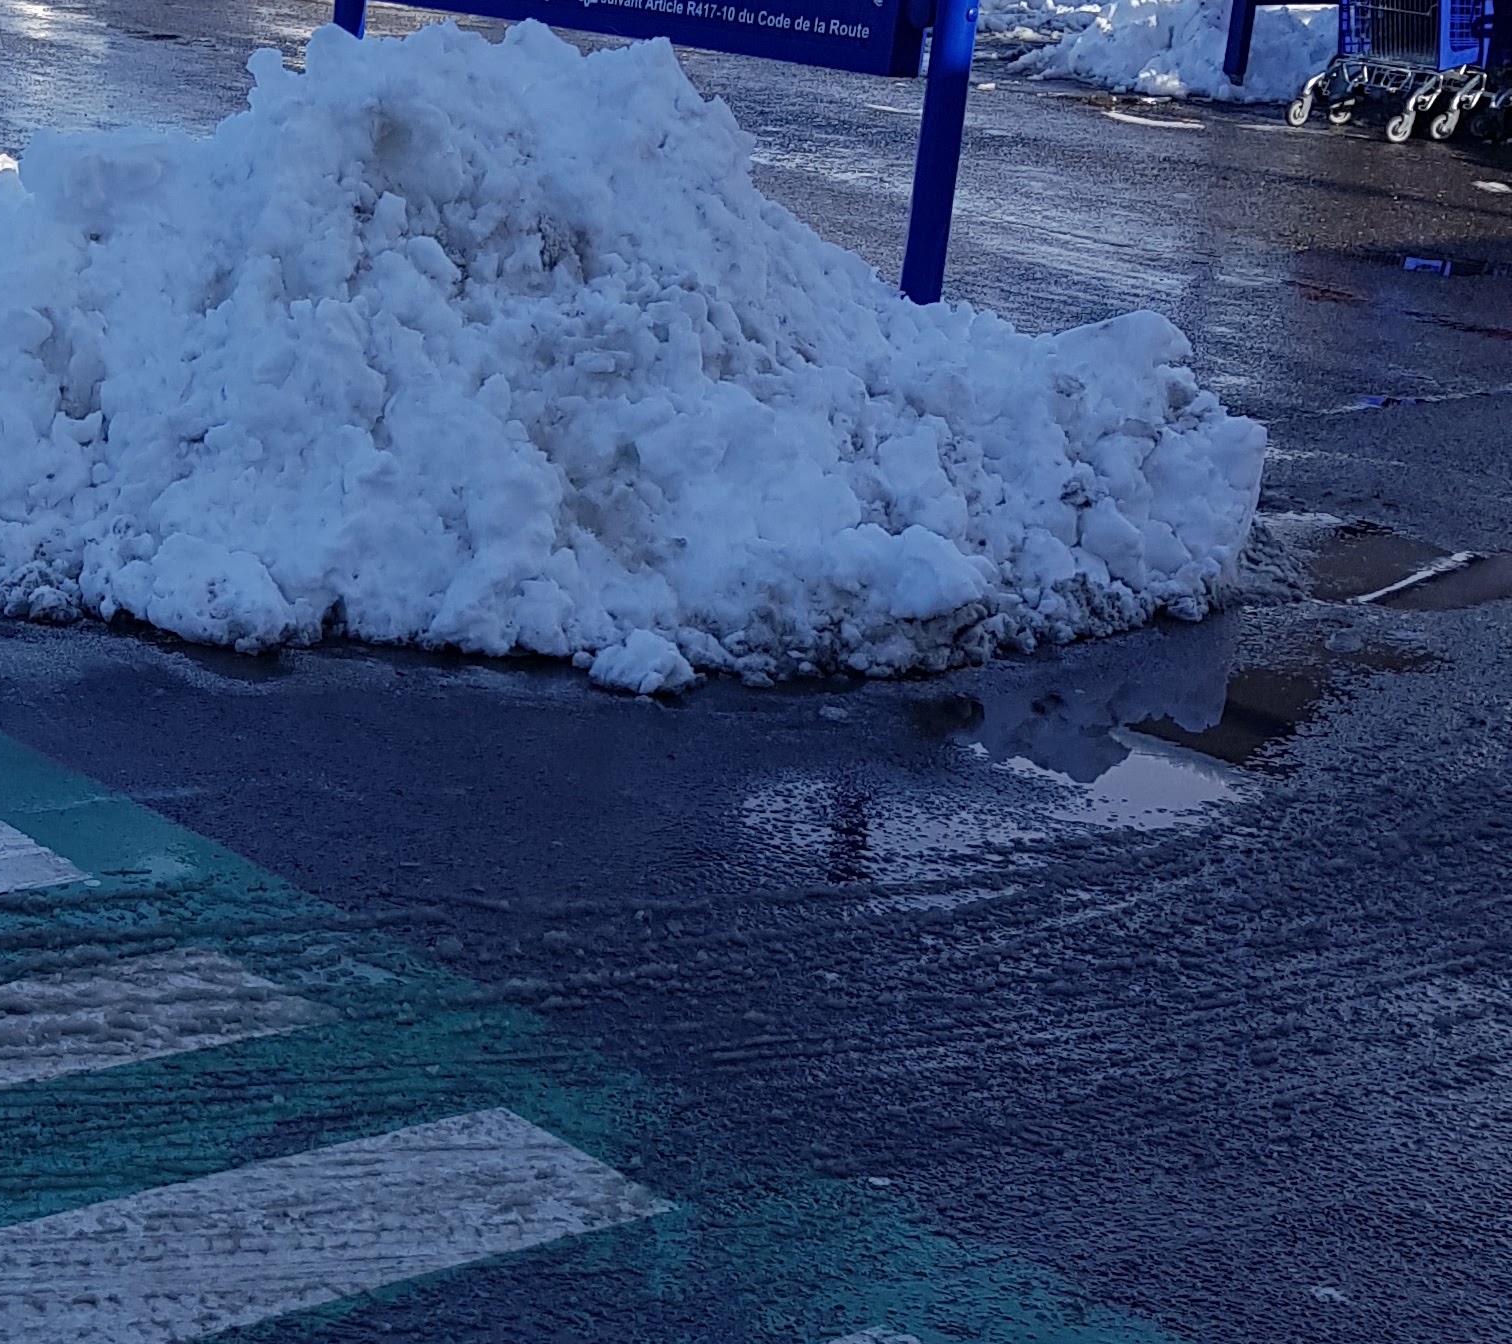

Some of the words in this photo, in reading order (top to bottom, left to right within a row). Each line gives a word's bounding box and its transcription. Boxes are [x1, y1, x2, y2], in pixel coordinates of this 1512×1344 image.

[687, 0, 735, 21] R417-10
[738, 8, 754, 24] du
[758, 10, 791, 29] Code
[794, 16, 811, 31] de
[813, 17, 826, 33] la
[829, 19, 870, 38] Route
